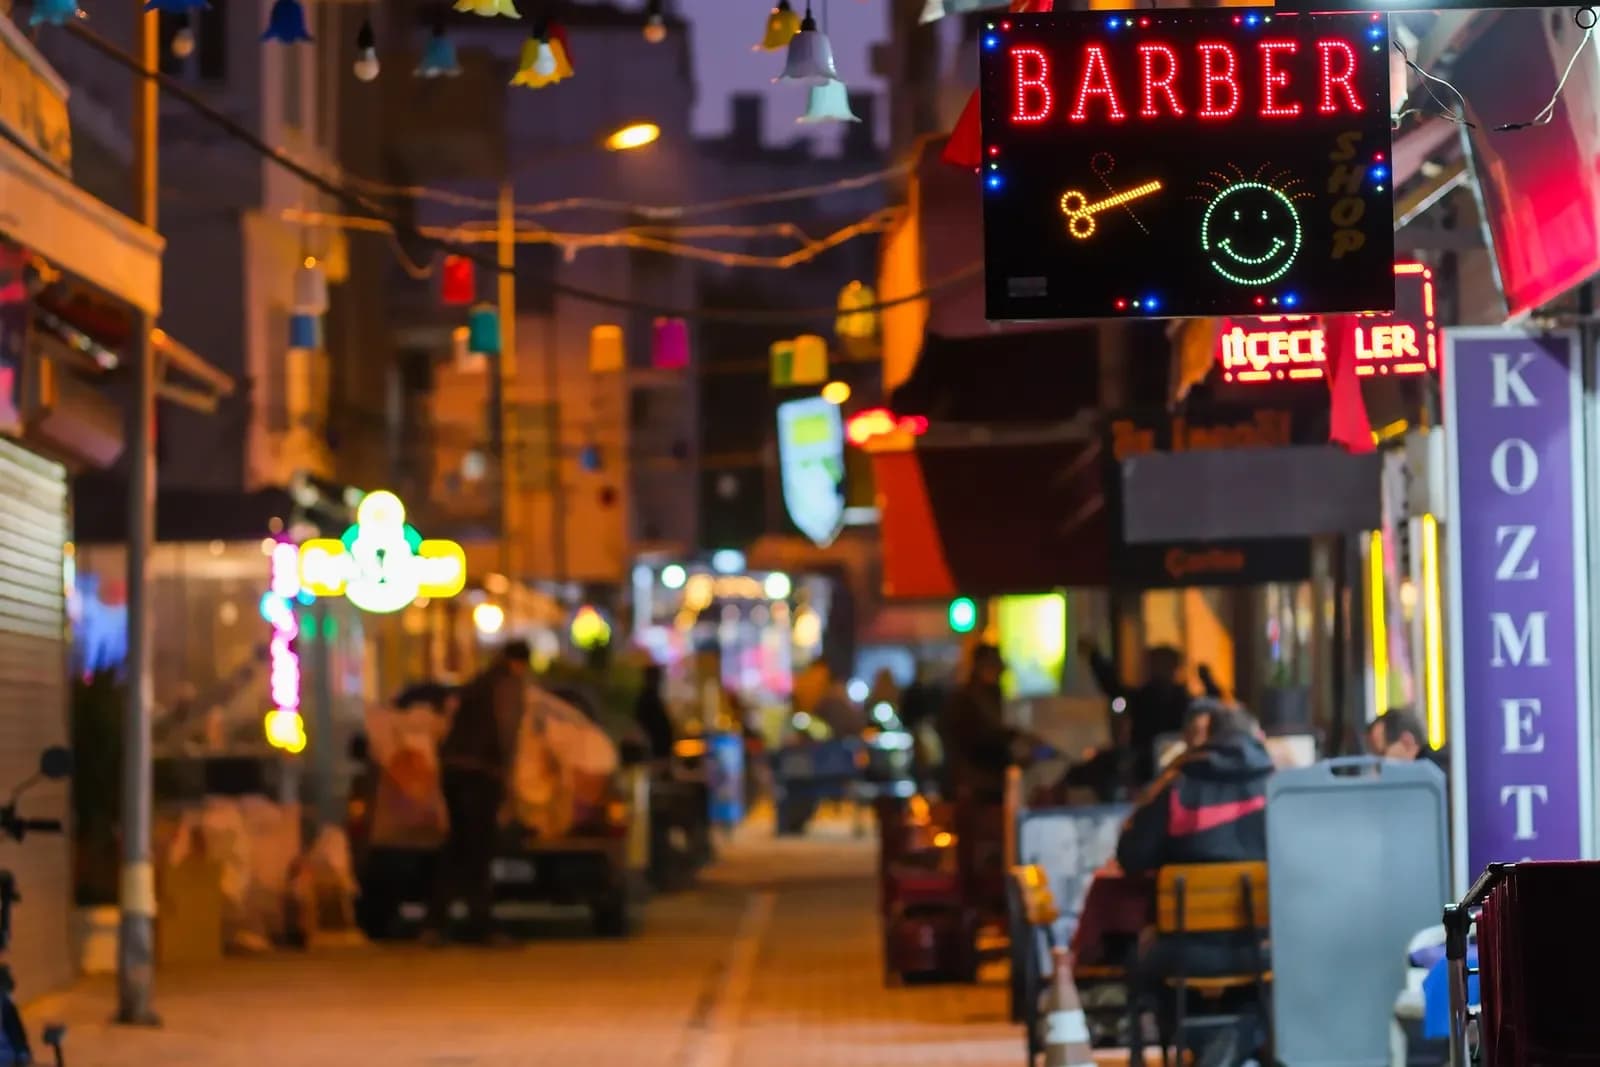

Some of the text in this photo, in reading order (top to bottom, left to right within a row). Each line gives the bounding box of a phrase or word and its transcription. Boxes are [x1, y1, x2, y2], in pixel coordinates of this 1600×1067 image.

[1010, 39, 1363, 122] BARBER
[1328, 130, 1366, 259] SHOP
[1489, 352, 1551, 862] KOZMET
